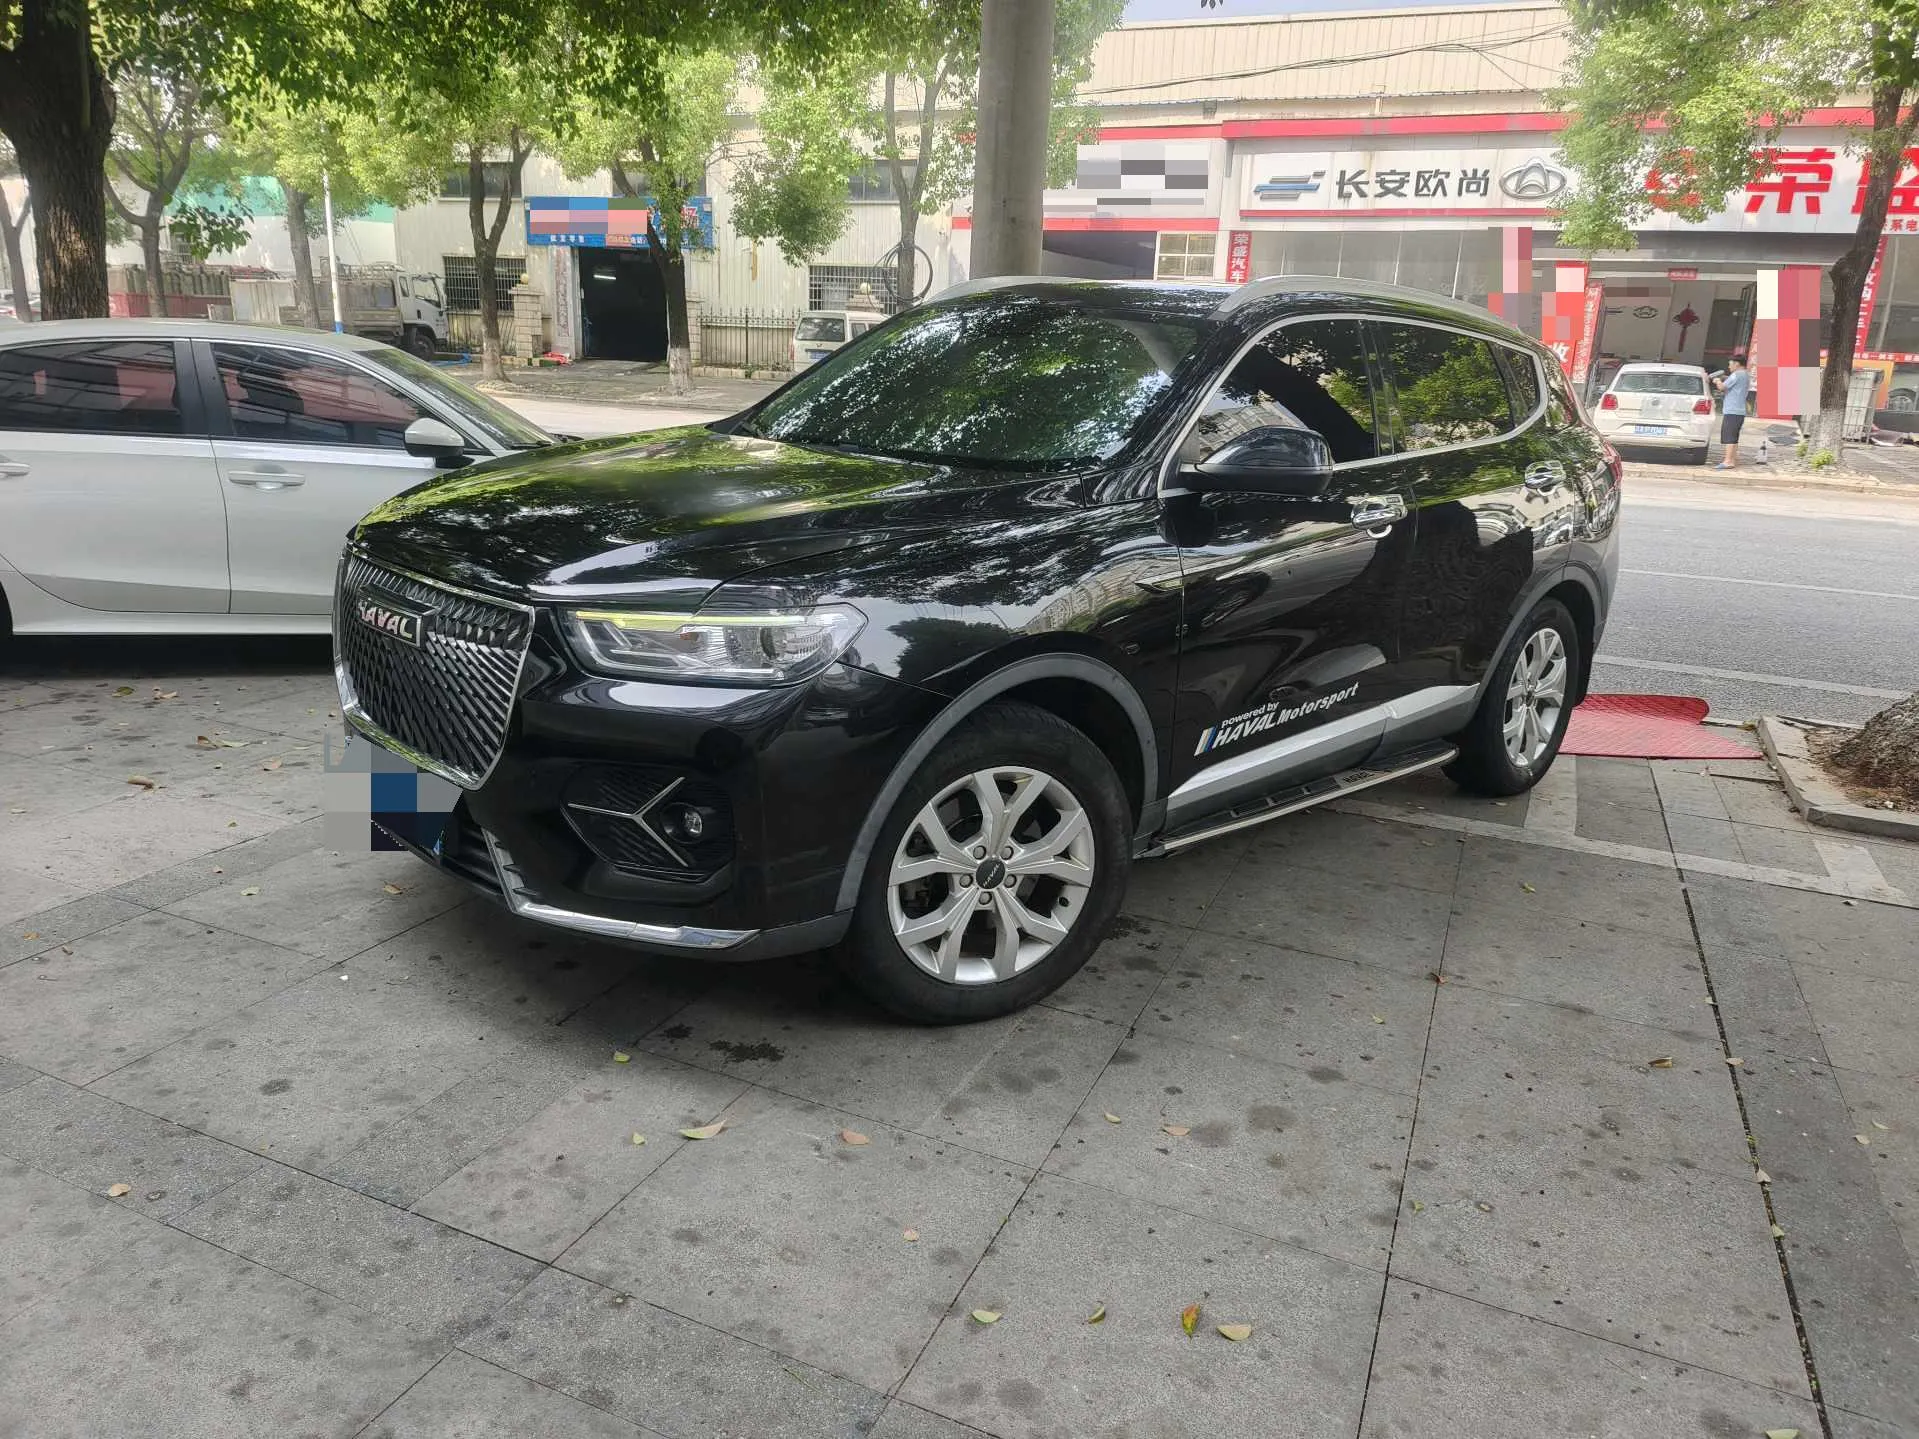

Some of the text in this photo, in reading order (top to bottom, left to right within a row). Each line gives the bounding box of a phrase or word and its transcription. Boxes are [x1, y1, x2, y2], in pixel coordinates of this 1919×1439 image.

[1335, 168, 1489, 199] 长安欧尚
[1212, 681, 1360, 750] HAVAL Motorsport
[1221, 701, 1280, 729] powered by
